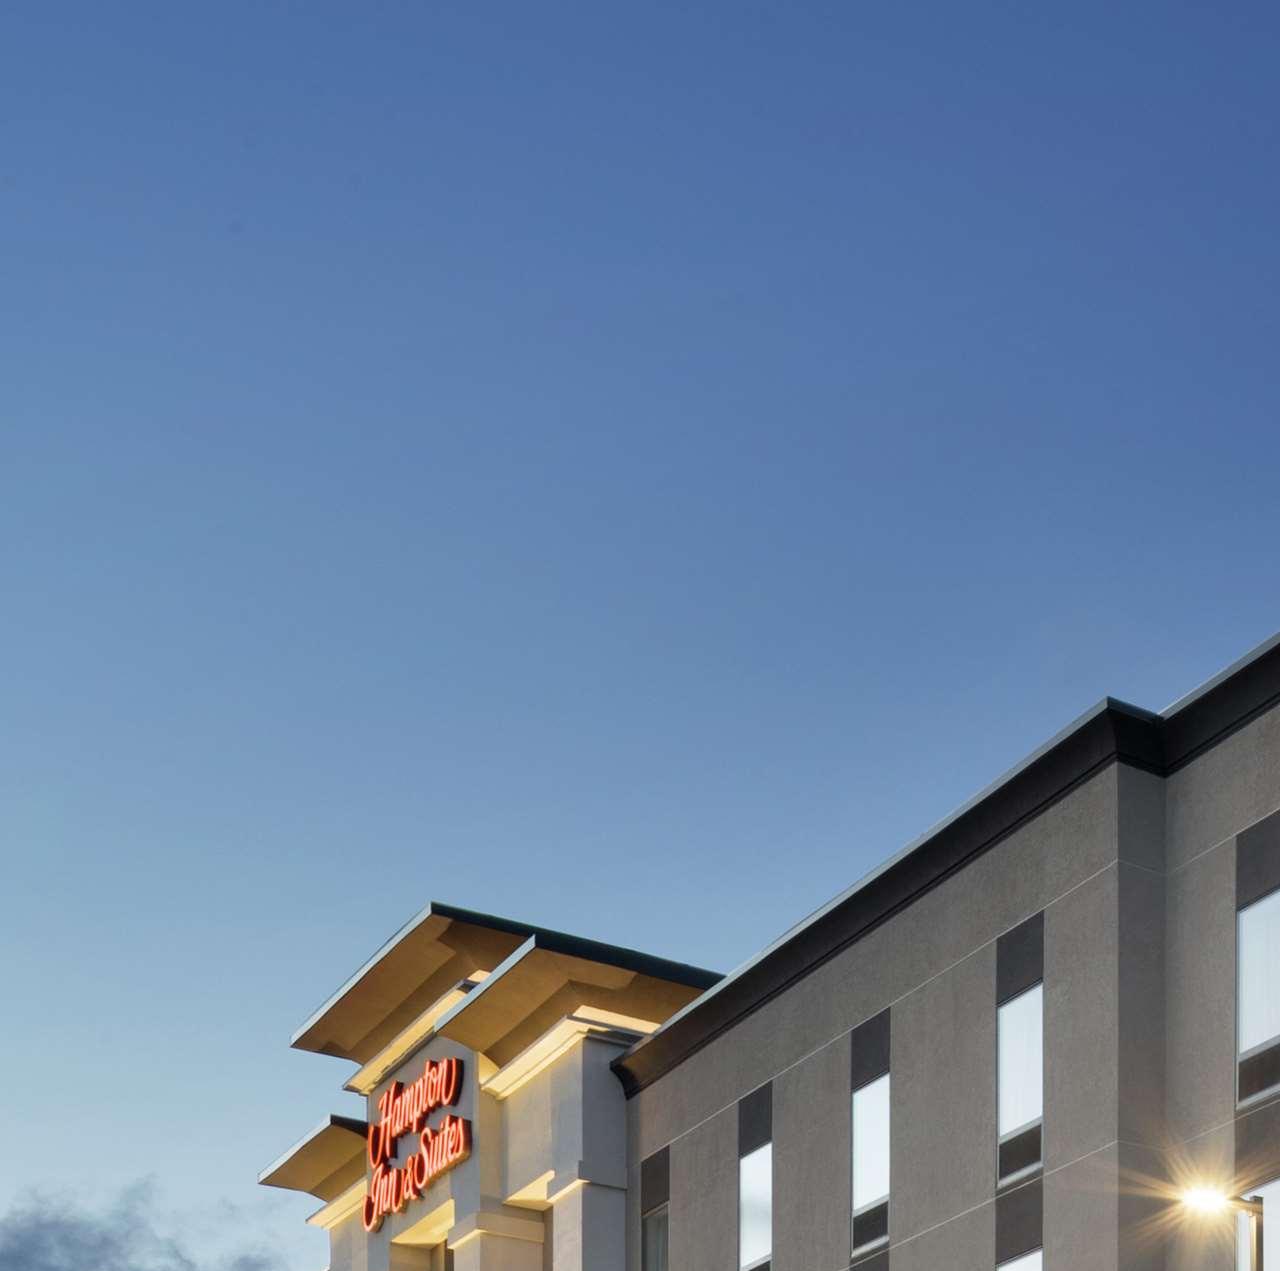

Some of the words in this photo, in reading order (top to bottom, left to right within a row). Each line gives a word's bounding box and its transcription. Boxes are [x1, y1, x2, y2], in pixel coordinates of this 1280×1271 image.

[368, 1056, 464, 1168] Hampton
[362, 1163, 406, 1232] Inn
[403, 1155, 419, 1200] &
[414, 1114, 471, 1189] Suites
